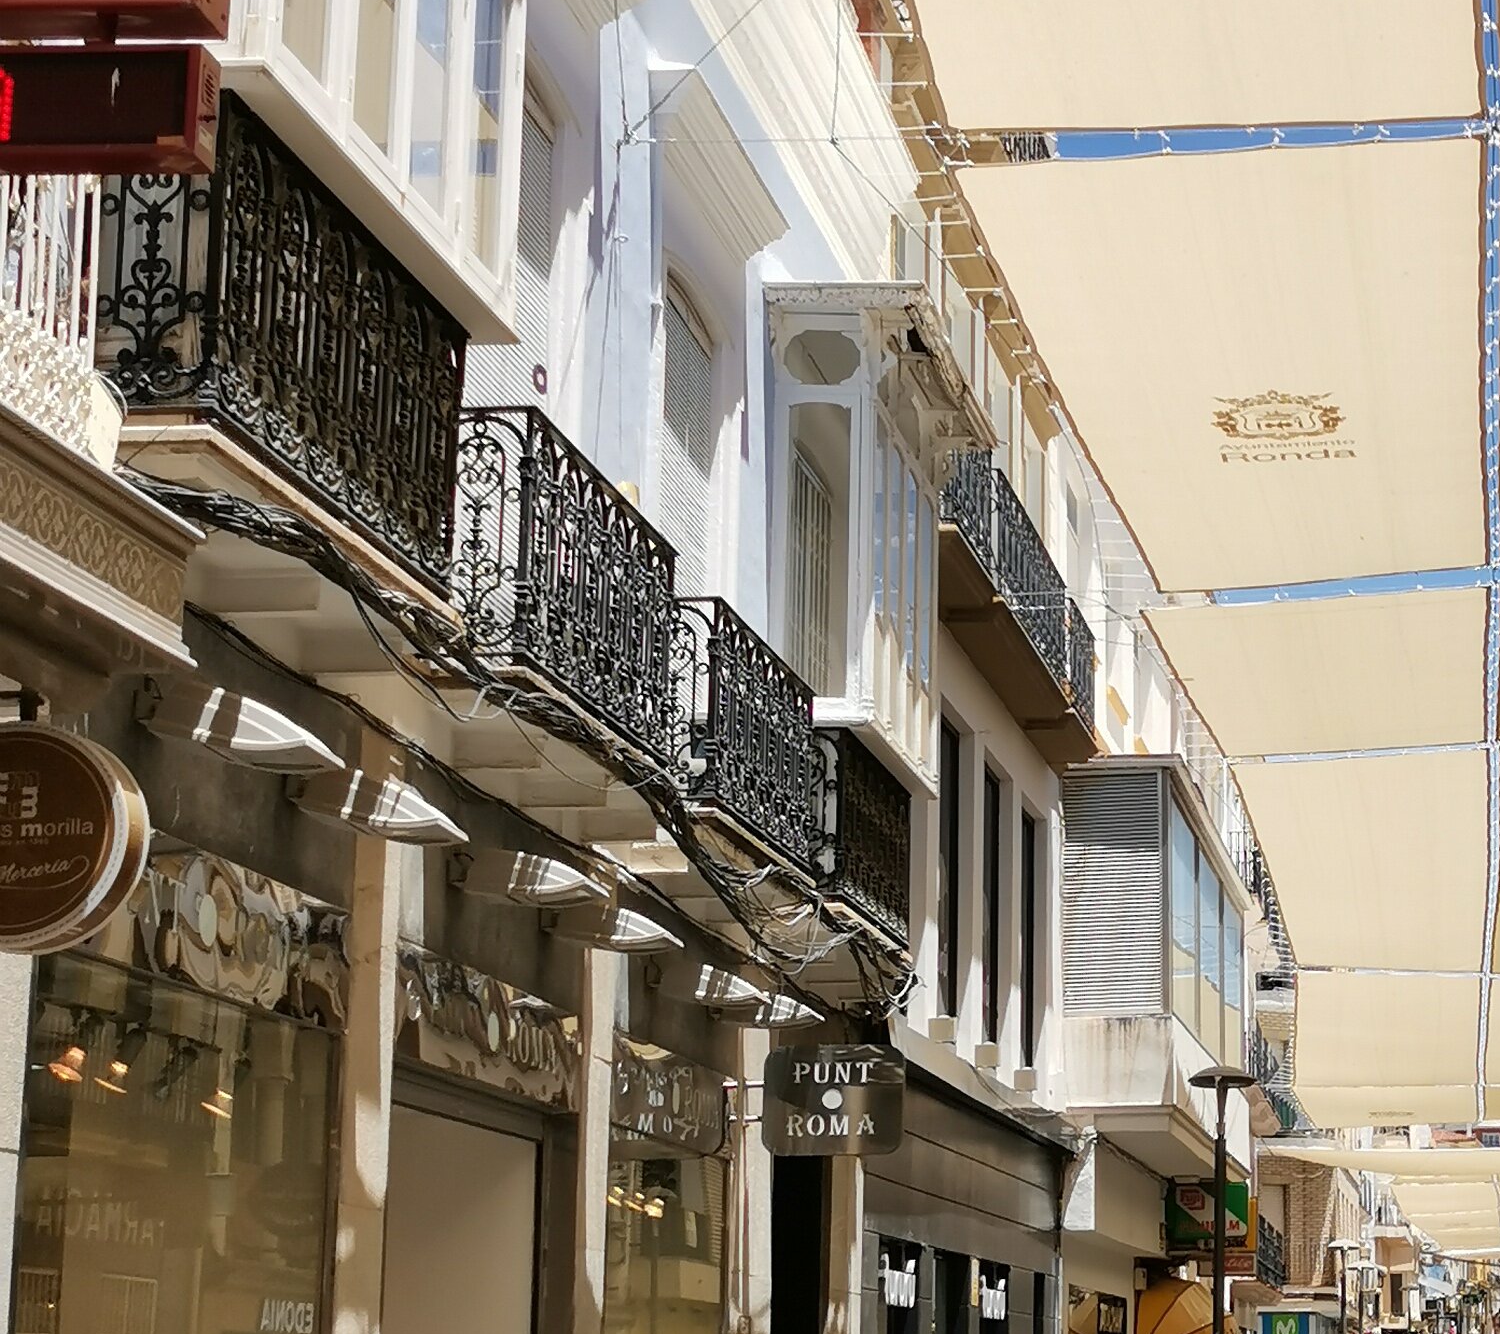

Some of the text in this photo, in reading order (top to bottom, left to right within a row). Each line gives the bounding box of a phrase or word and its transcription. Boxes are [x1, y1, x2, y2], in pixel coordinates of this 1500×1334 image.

[1220, 447, 1357, 464] Ronda
[20, 817, 94, 838] morilla
[792, 1061, 874, 1084] PUNT
[786, 1113, 875, 1138] ROMA
